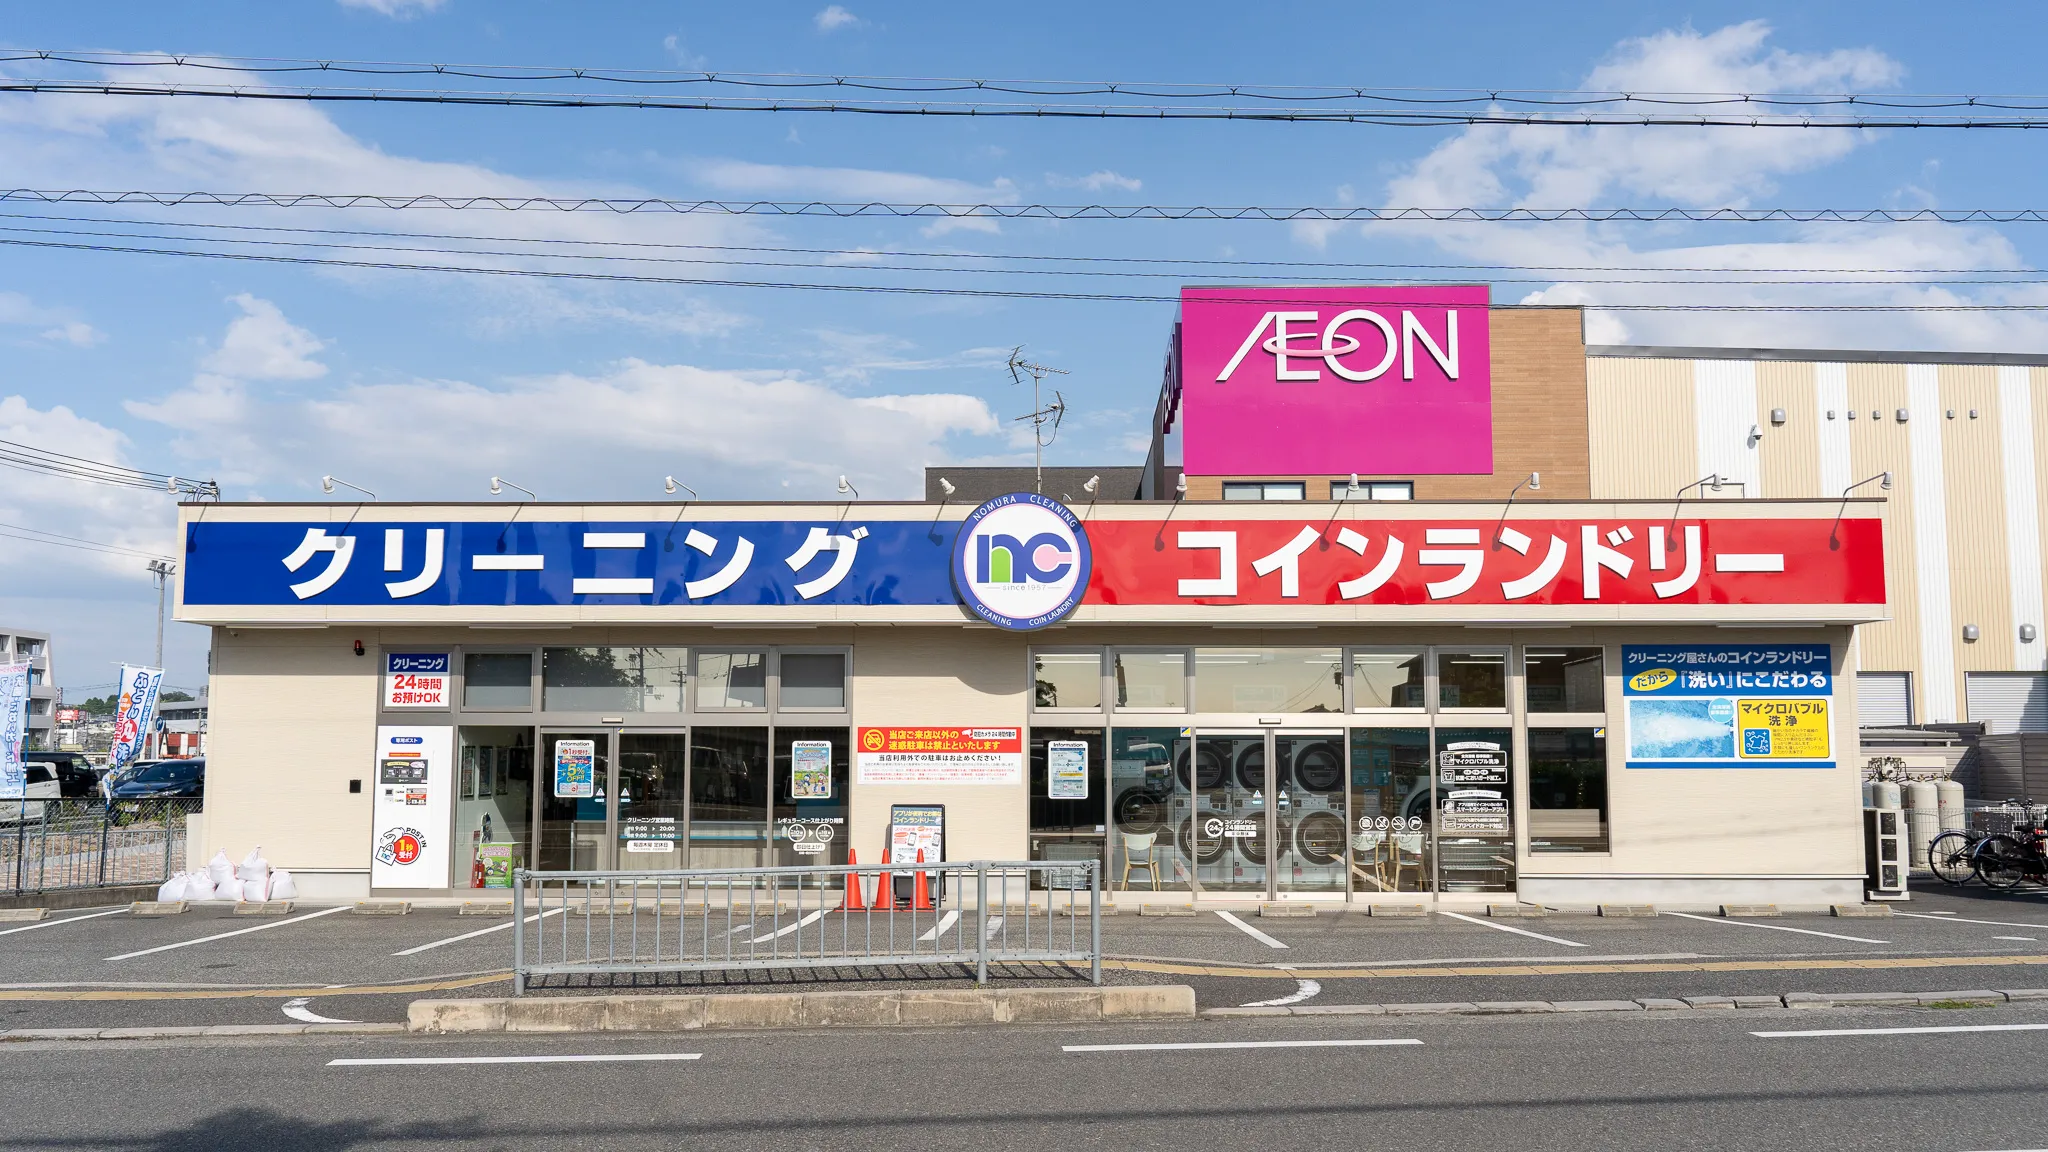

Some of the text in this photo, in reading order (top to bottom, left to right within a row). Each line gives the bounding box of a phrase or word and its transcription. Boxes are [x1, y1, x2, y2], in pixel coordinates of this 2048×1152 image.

[972, 495, 1078, 528] NOMURA CLEANING
[281, 526, 869, 600] クリーニング
[1177, 524, 1784, 600] コインランドリー
[976, 596, 1074, 626] CLEANING COIN LAUNDRY
[393, 658, 445, 670] クリーニング
[1628, 651, 1827, 664] クリーニング屋さんのコインランドリー
[394, 674, 442, 690] 24時間
[1636, 671, 1669, 687] だから
[1681, 670, 1827, 688] 『洗い』にこだわる
[392, 692, 441, 703] お預けOK
[1741, 703, 1824, 715] マイクロバブル
[889, 730, 959, 739] 当店ご来店以外の
[888, 741, 1000, 750] 迷惑駐車は禁止といたします
[406, 827, 424, 839] POST
